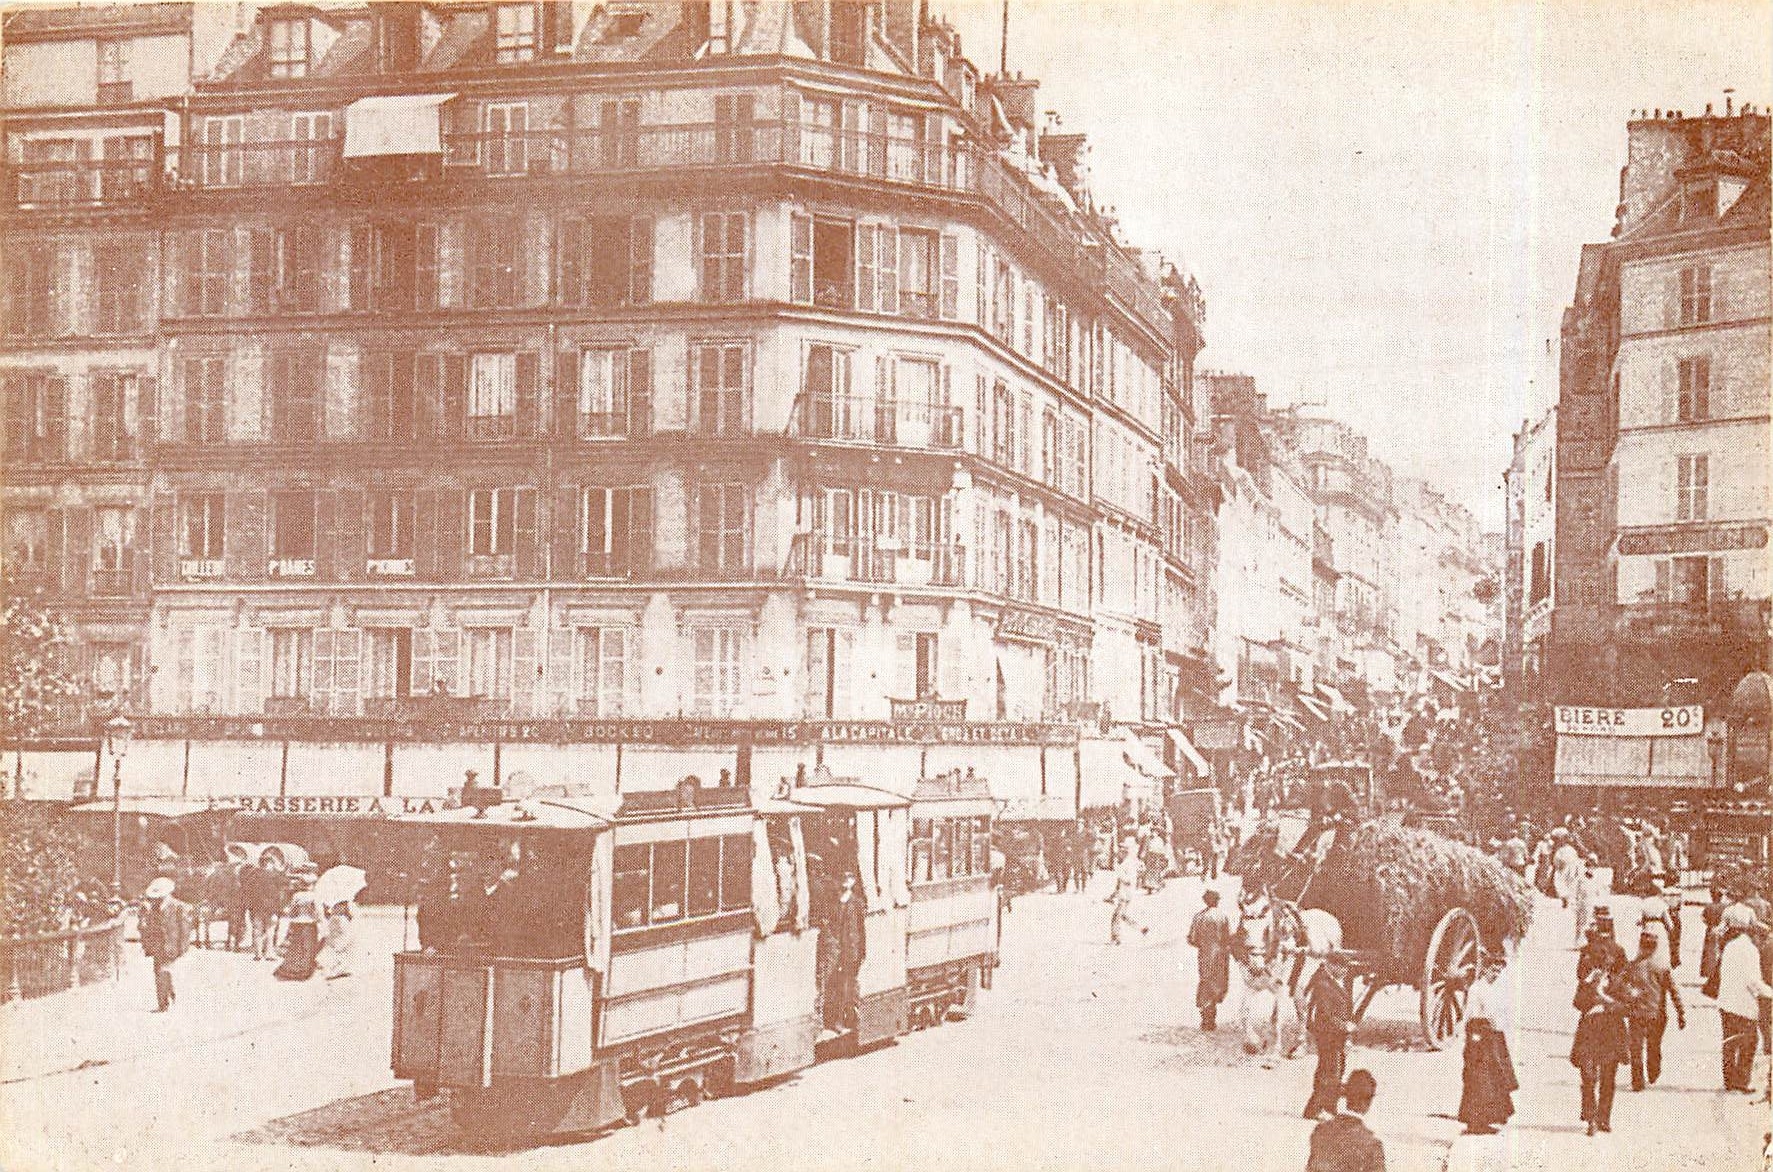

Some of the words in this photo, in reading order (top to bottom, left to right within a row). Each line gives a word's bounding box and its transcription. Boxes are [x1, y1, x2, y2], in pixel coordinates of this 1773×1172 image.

[1559, 707, 1626, 726] BIERE
[369, 796, 386, 814] A
[402, 796, 435, 814] LA
